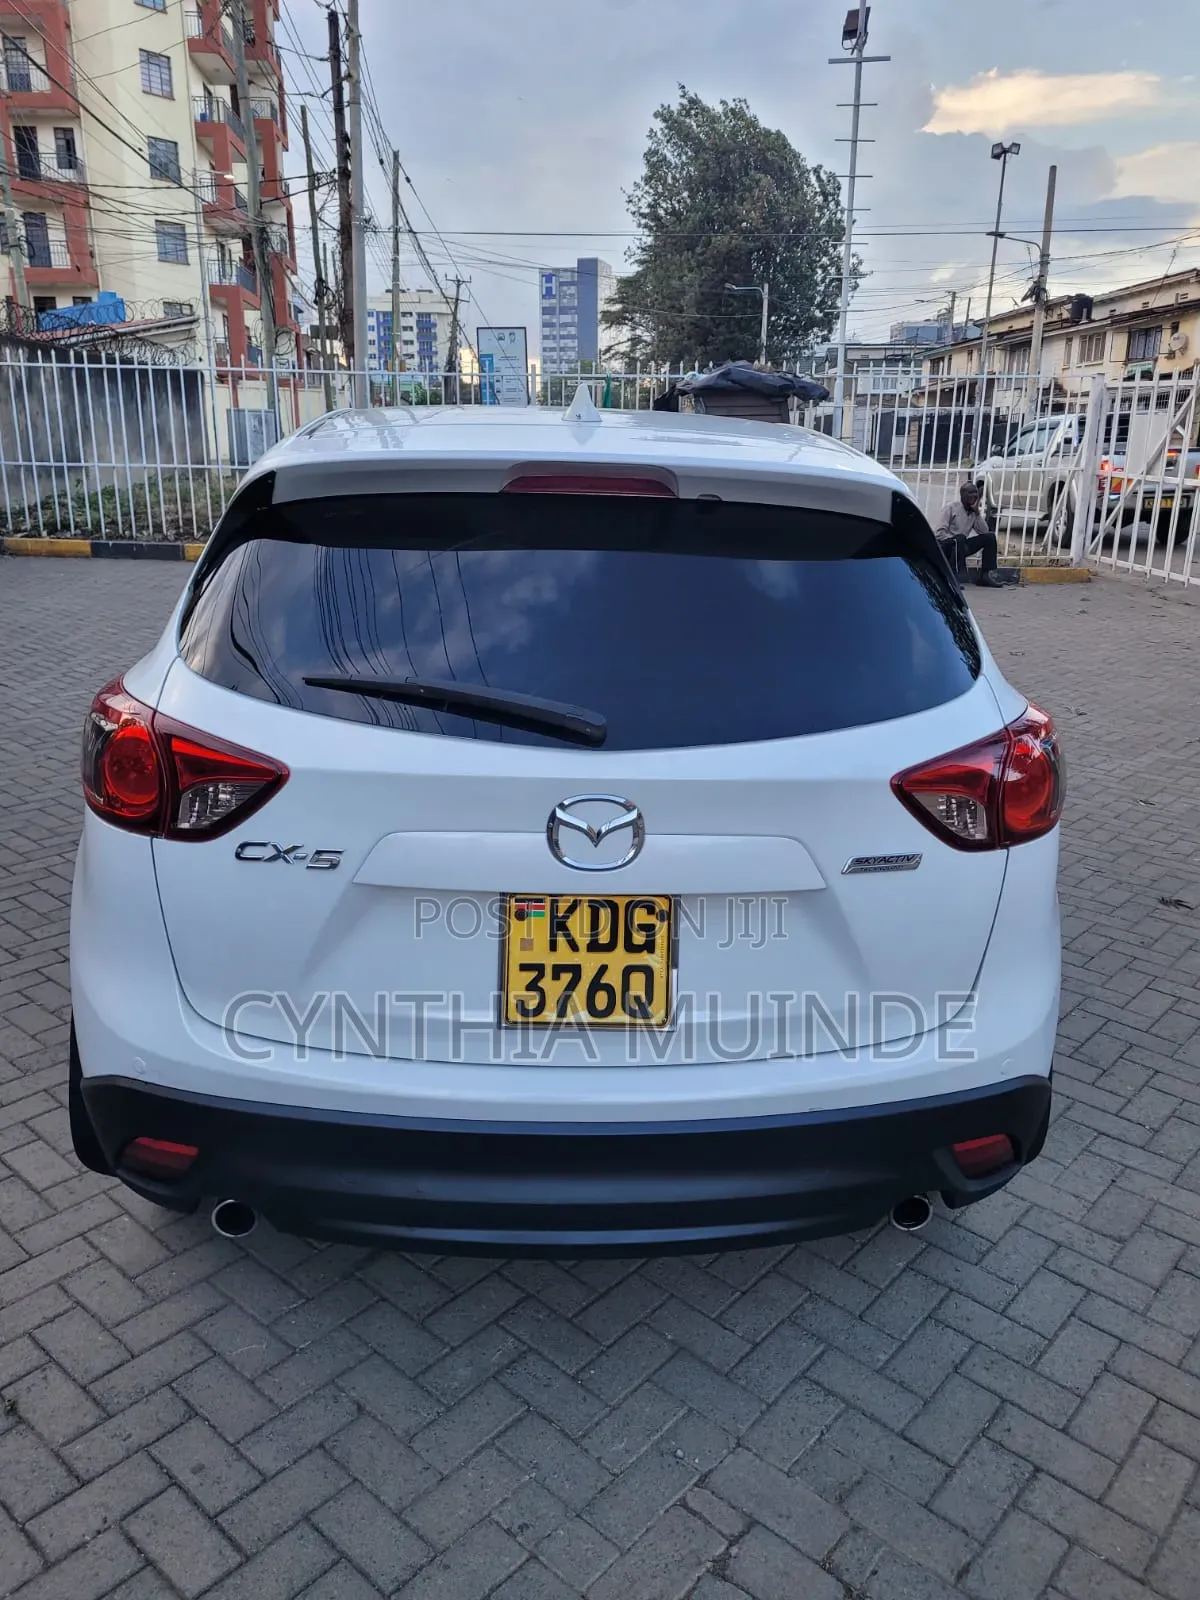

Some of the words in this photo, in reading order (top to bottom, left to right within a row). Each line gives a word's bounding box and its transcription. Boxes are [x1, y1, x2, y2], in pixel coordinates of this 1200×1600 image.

[234, 840, 345, 870] CX-5
[854, 855, 915, 864] SKYACTIV
[550, 899, 656, 953] KDG
[516, 963, 654, 1019] 376Q
